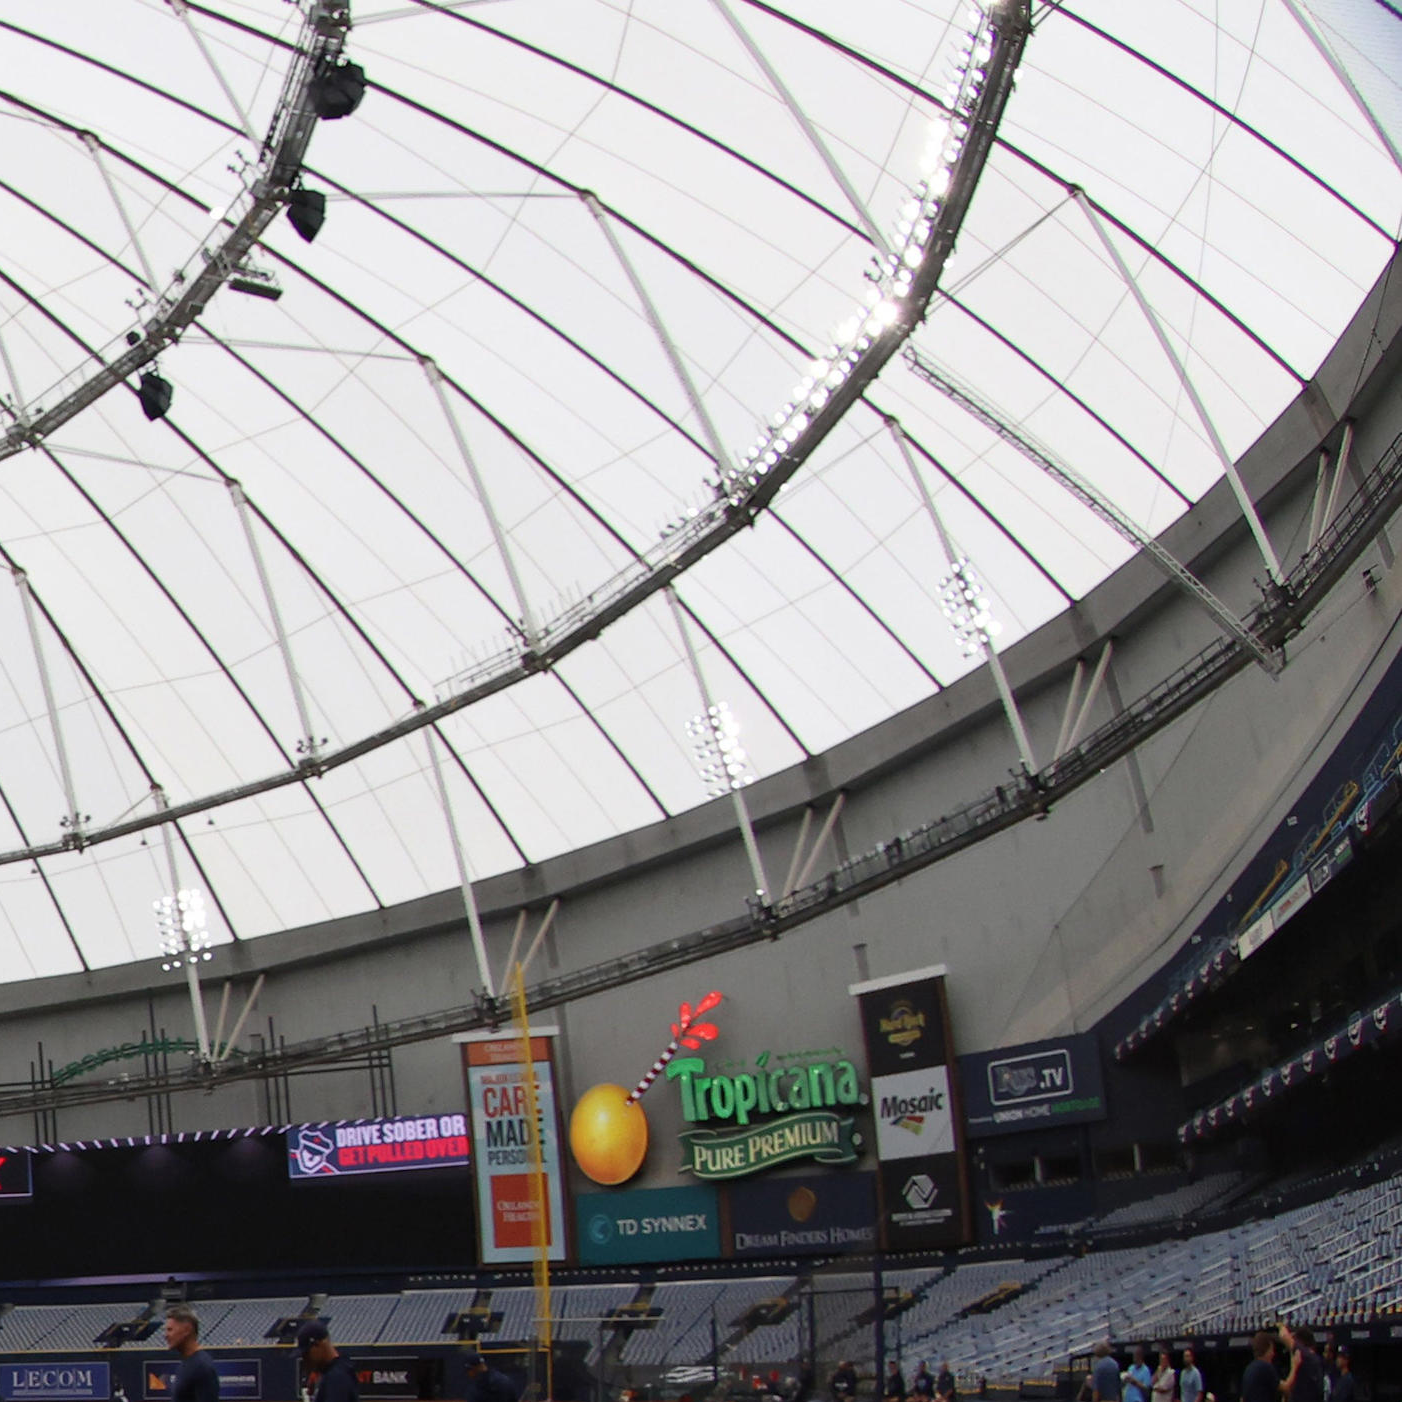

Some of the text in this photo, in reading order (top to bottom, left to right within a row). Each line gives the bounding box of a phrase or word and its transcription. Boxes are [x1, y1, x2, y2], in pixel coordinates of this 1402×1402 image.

[666, 1051, 860, 1125] Tropicana
[881, 1086, 944, 1119] Mosaic
[335, 1114, 467, 1148] DRIVE SOBER OR
[695, 1120, 839, 1172] PURE PREMIUM
[338, 1135, 470, 1167] GET PULLED OVER
[617, 1214, 707, 1235] TD SYNNEX
[735, 1225, 875, 1250] DREAM FINDERS HOMES
[11, 1370, 94, 1388] LECOM
[372, 1371, 409, 1384] BANK
